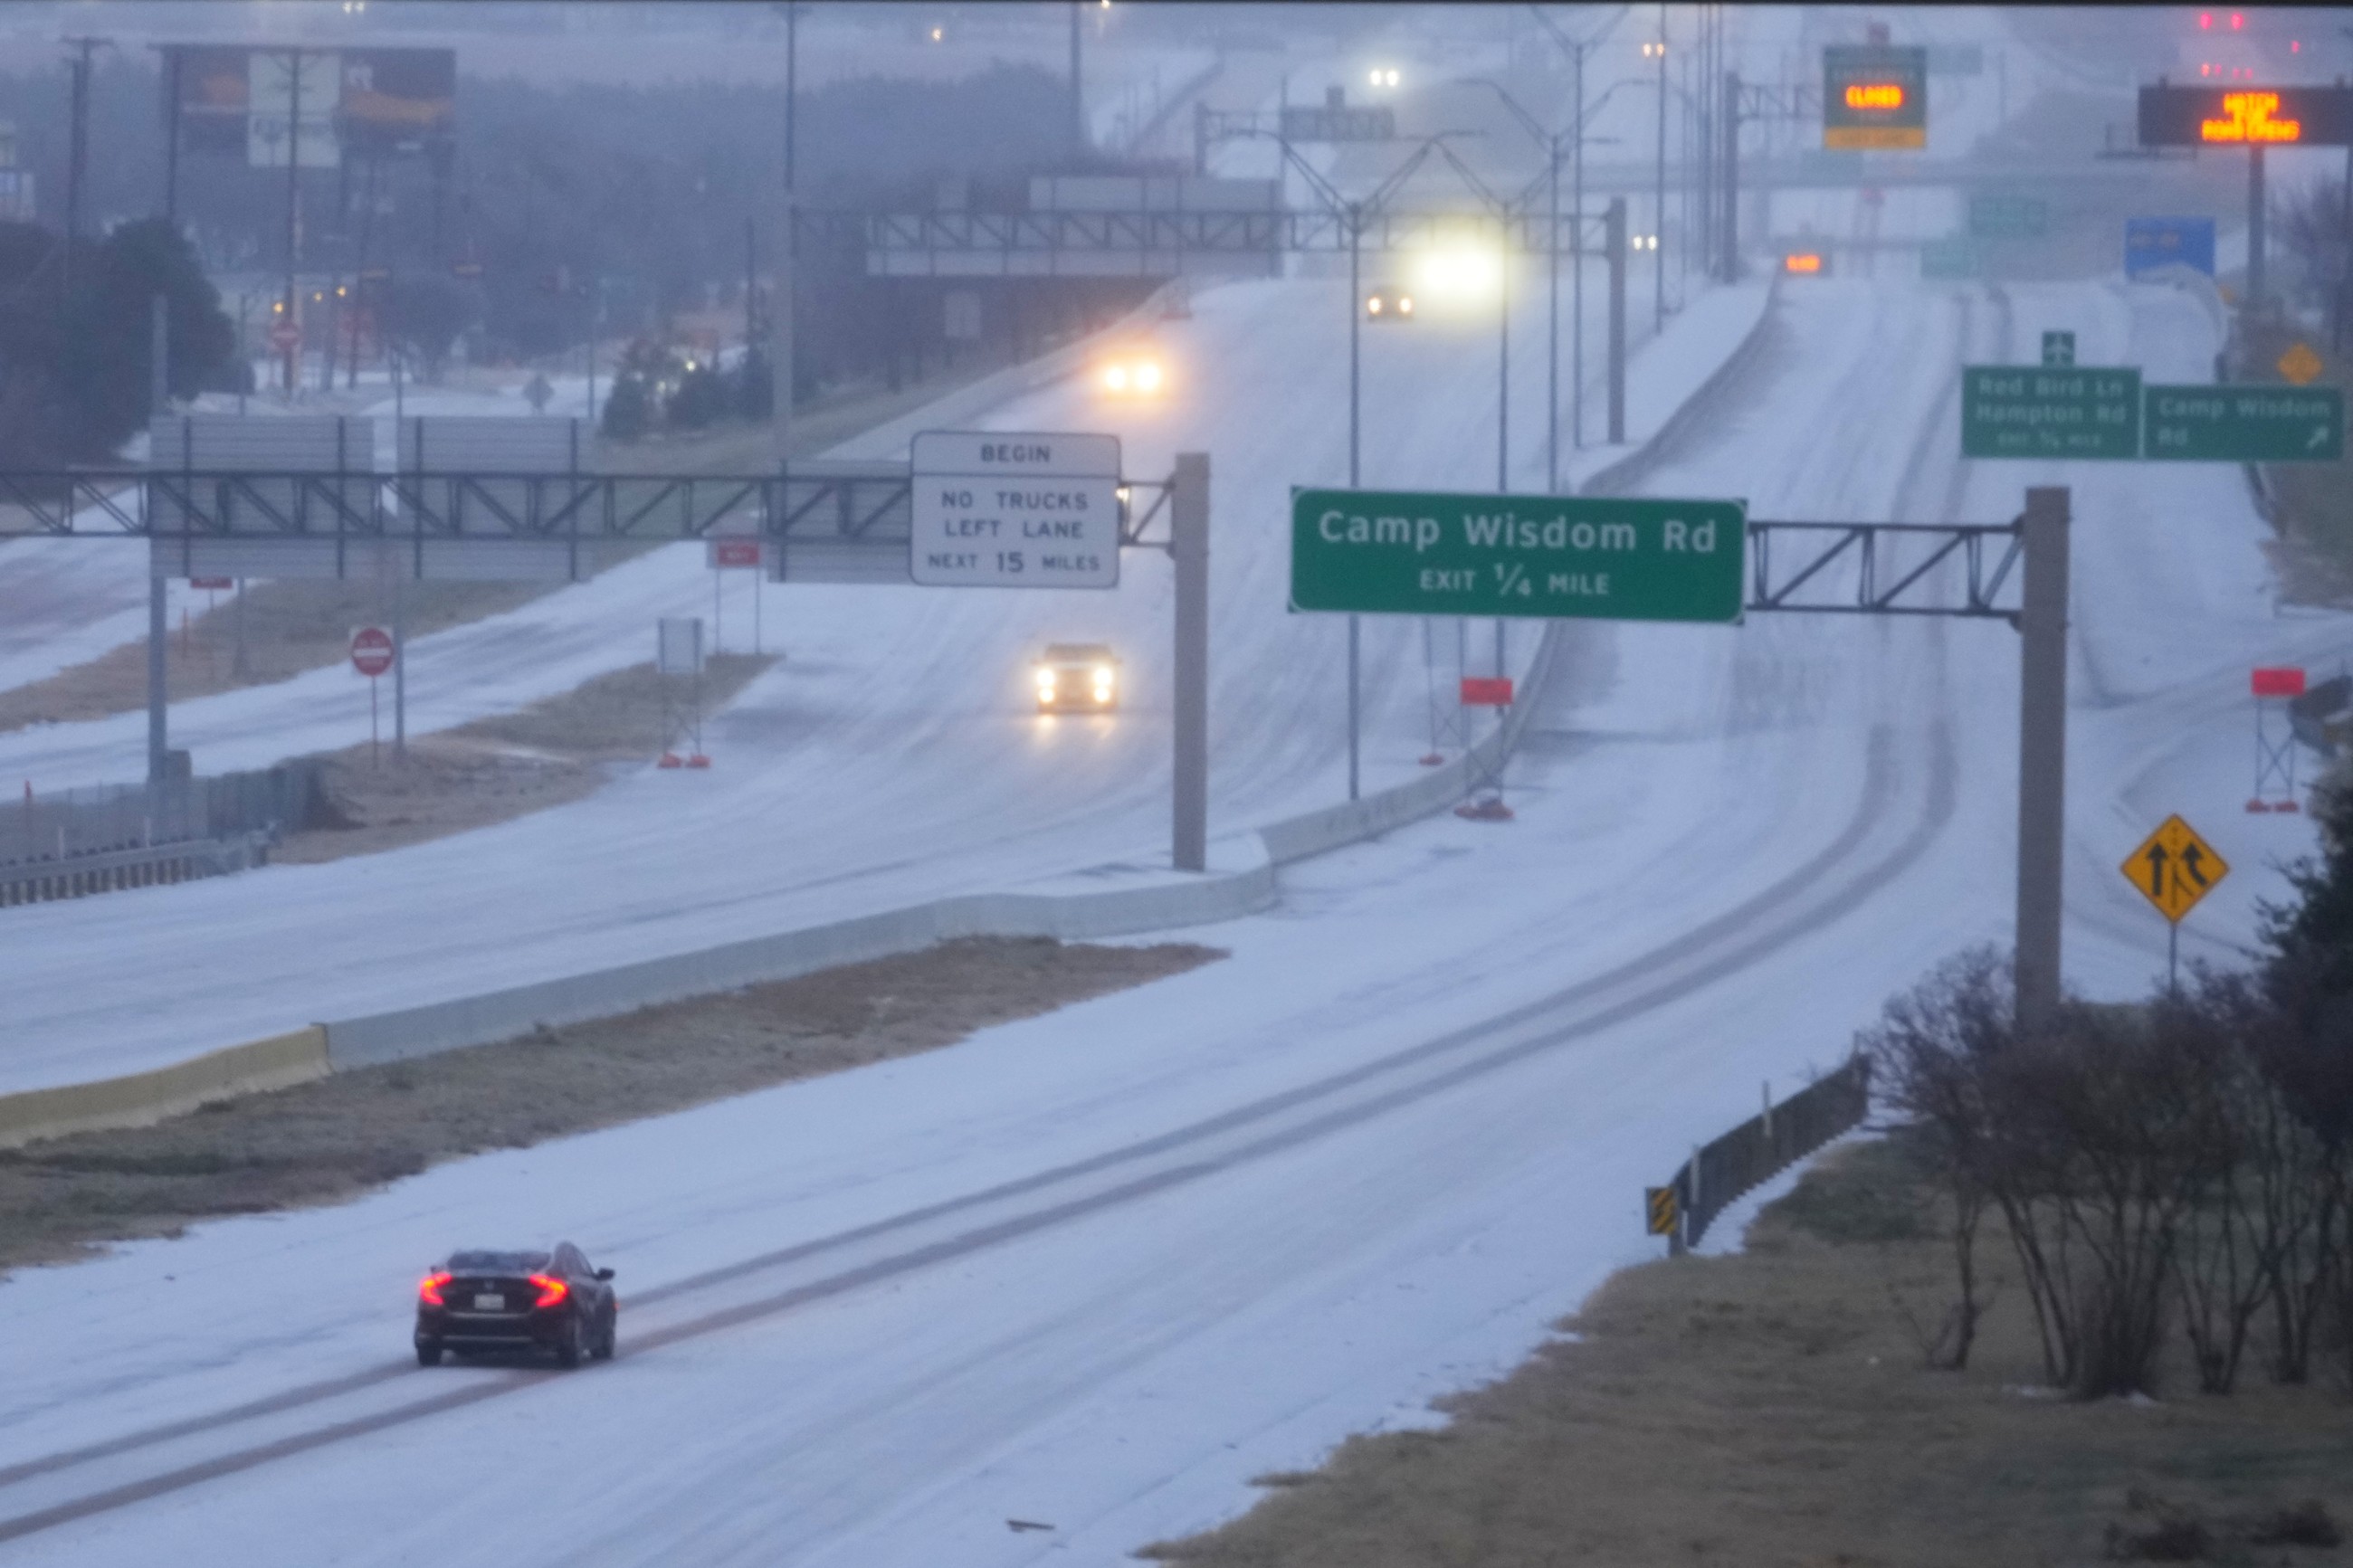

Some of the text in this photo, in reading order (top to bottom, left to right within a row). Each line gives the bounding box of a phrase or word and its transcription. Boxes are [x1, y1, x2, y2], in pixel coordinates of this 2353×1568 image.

[1846, 85, 1902, 109] CLOSED
[2036, 377, 2083, 396] Bird
[2159, 398, 2329, 419] Camp Wisdom
[980, 444, 1049, 462] BEGIN
[941, 491, 1088, 510] NO TRUCKS
[945, 519, 1084, 538] LEFT LANE
[1318, 510, 1717, 553] Camp Wisdom Rd
[928, 551, 1100, 573] NEXT 15 MILES
[1419, 569, 1476, 591] EXIT
[1548, 573, 1610, 594] MILE
